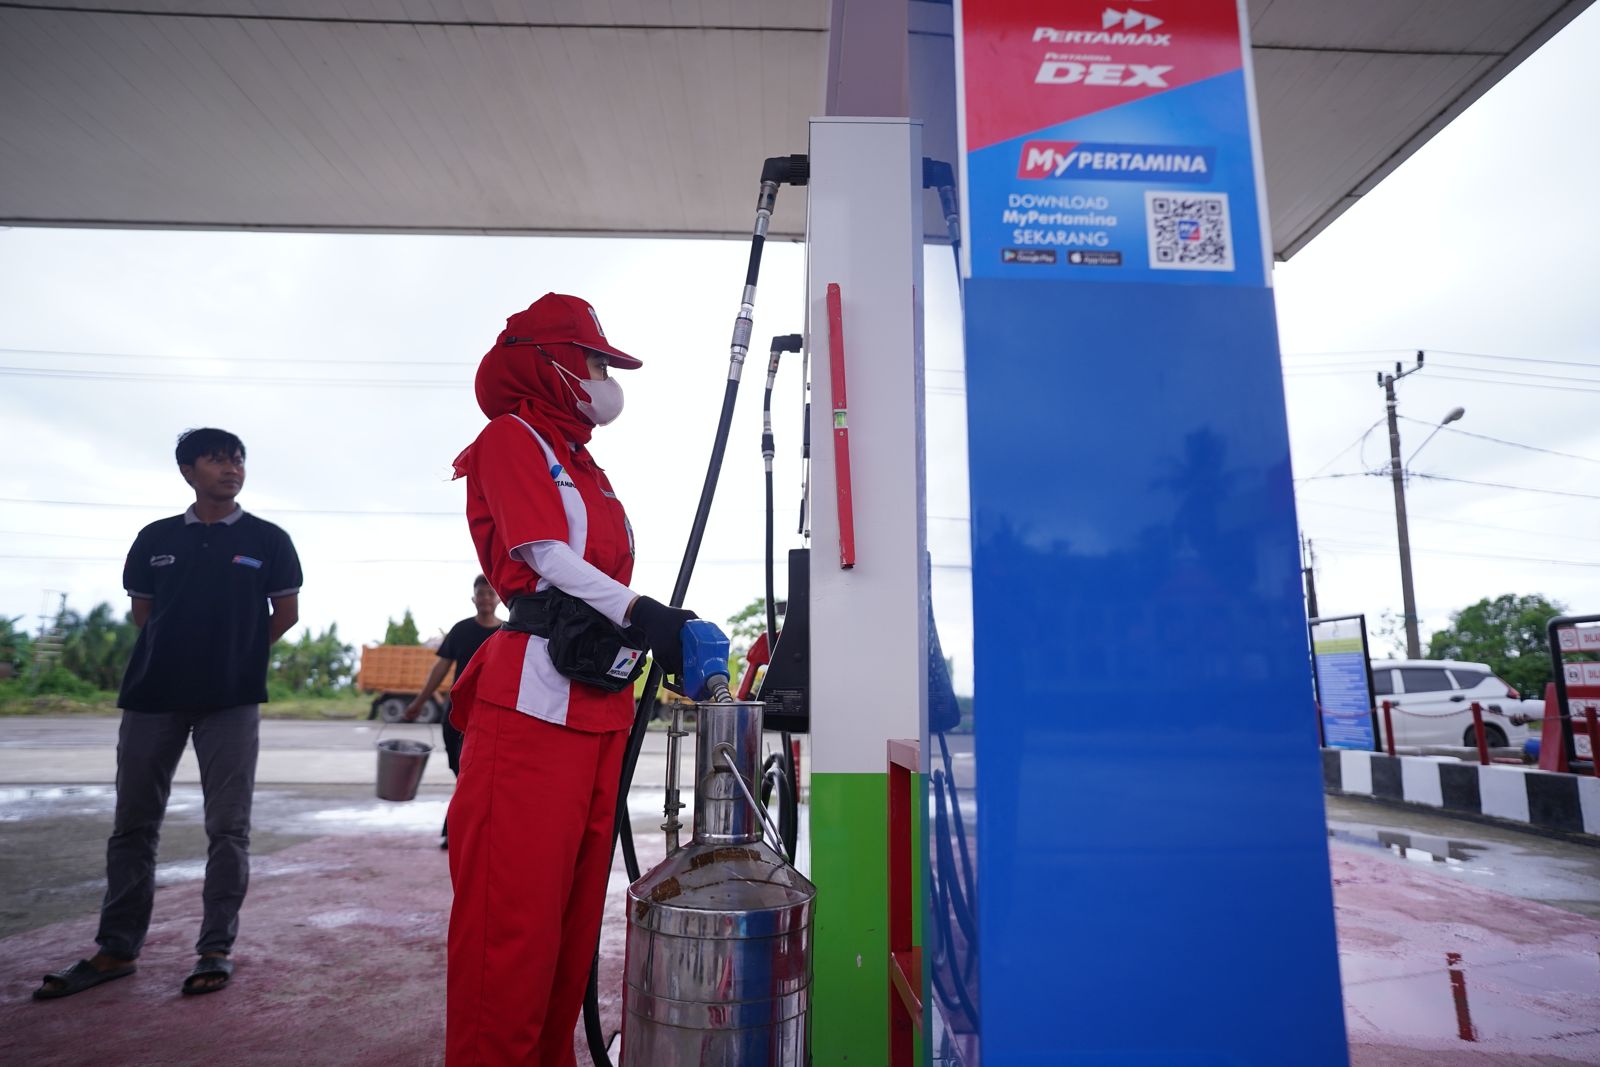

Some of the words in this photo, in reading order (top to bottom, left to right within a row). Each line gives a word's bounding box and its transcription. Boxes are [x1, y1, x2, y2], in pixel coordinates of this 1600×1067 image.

[1032, 27, 1172, 46] PERTAMAX
[1034, 61, 1174, 88] DEX
[1008, 193, 1109, 210] DOWNLOAD
[1002, 209, 1118, 227] MyPertamina
[1013, 229, 1109, 247] SEKARANG
